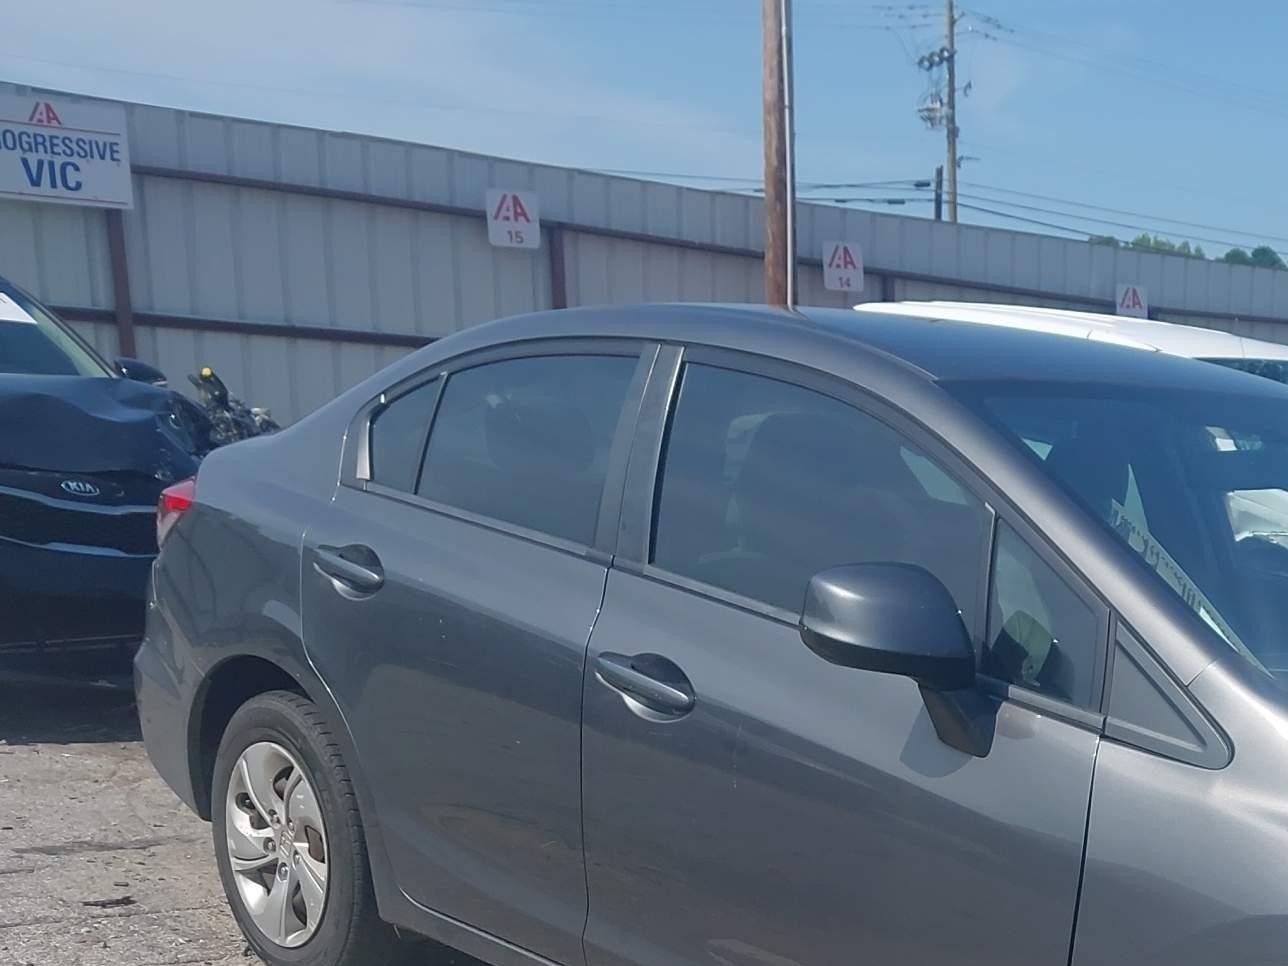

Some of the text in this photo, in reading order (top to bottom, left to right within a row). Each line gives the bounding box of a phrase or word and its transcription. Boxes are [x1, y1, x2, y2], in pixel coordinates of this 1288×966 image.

[0, 129, 121, 162] OGRESSIVE
[20, 157, 82, 191] VIC
[507, 230, 524, 244] 15
